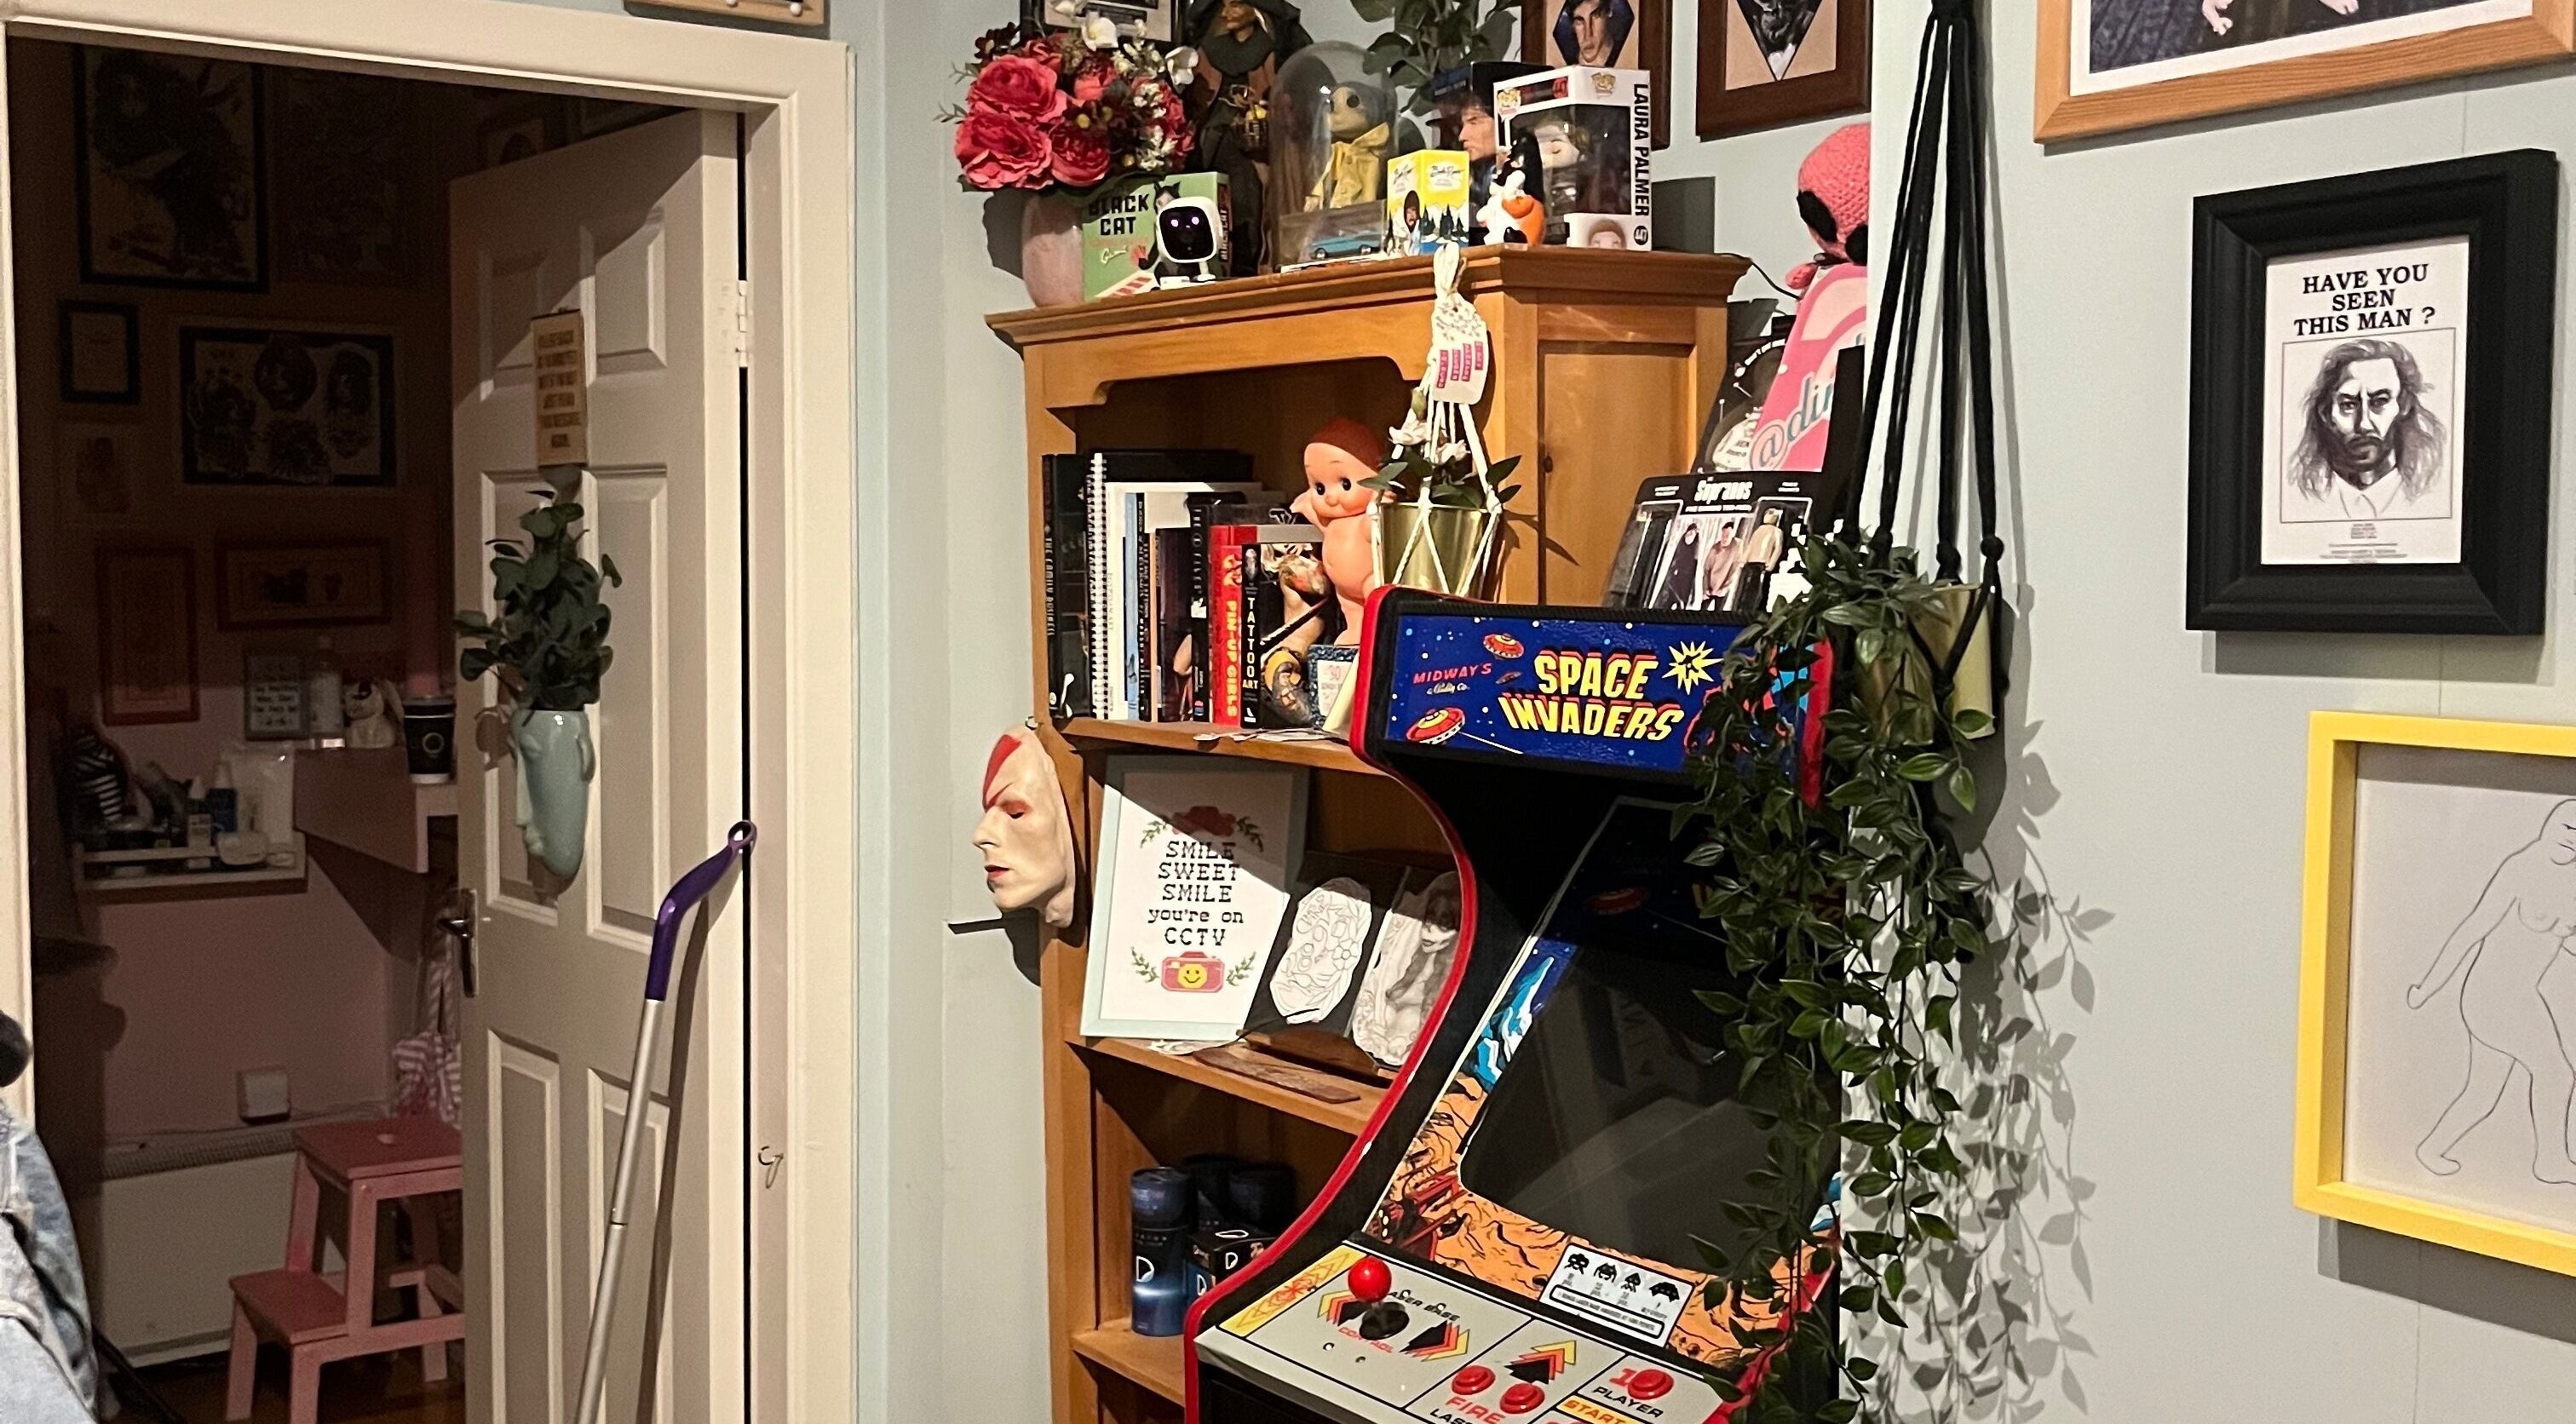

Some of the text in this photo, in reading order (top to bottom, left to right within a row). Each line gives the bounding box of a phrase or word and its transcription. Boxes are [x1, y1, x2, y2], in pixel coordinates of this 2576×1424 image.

[1633, 83, 1649, 141] LAURA
[1635, 146, 1650, 216] PALMER
[1089, 193, 1150, 216] BLACK
[1100, 215, 1136, 236] CAT
[2303, 264, 2429, 295] HAVE YOU
[2332, 289, 2395, 312] SEEN
[2294, 307, 2436, 337] THIS MAN ?
[1246, 597, 1256, 678] TATTOO
[1226, 600, 1238, 718] PIN-UP GIRLS
[1242, 679, 1259, 690] ART
[1533, 652, 1659, 700] SPACE
[1498, 694, 1685, 742] INVADERS
[1165, 841, 1237, 860] SMILE
[1158, 863, 1240, 881] SWEET
[1161, 883, 1233, 904] SMILE
[1147, 907, 1244, 925] you're on
[1164, 927, 1227, 946] CCTV
[1445, 1395, 1506, 1424] FIRE
[1563, 1399, 1626, 1424] START
[1593, 1386, 1664, 1418] PLAYER
